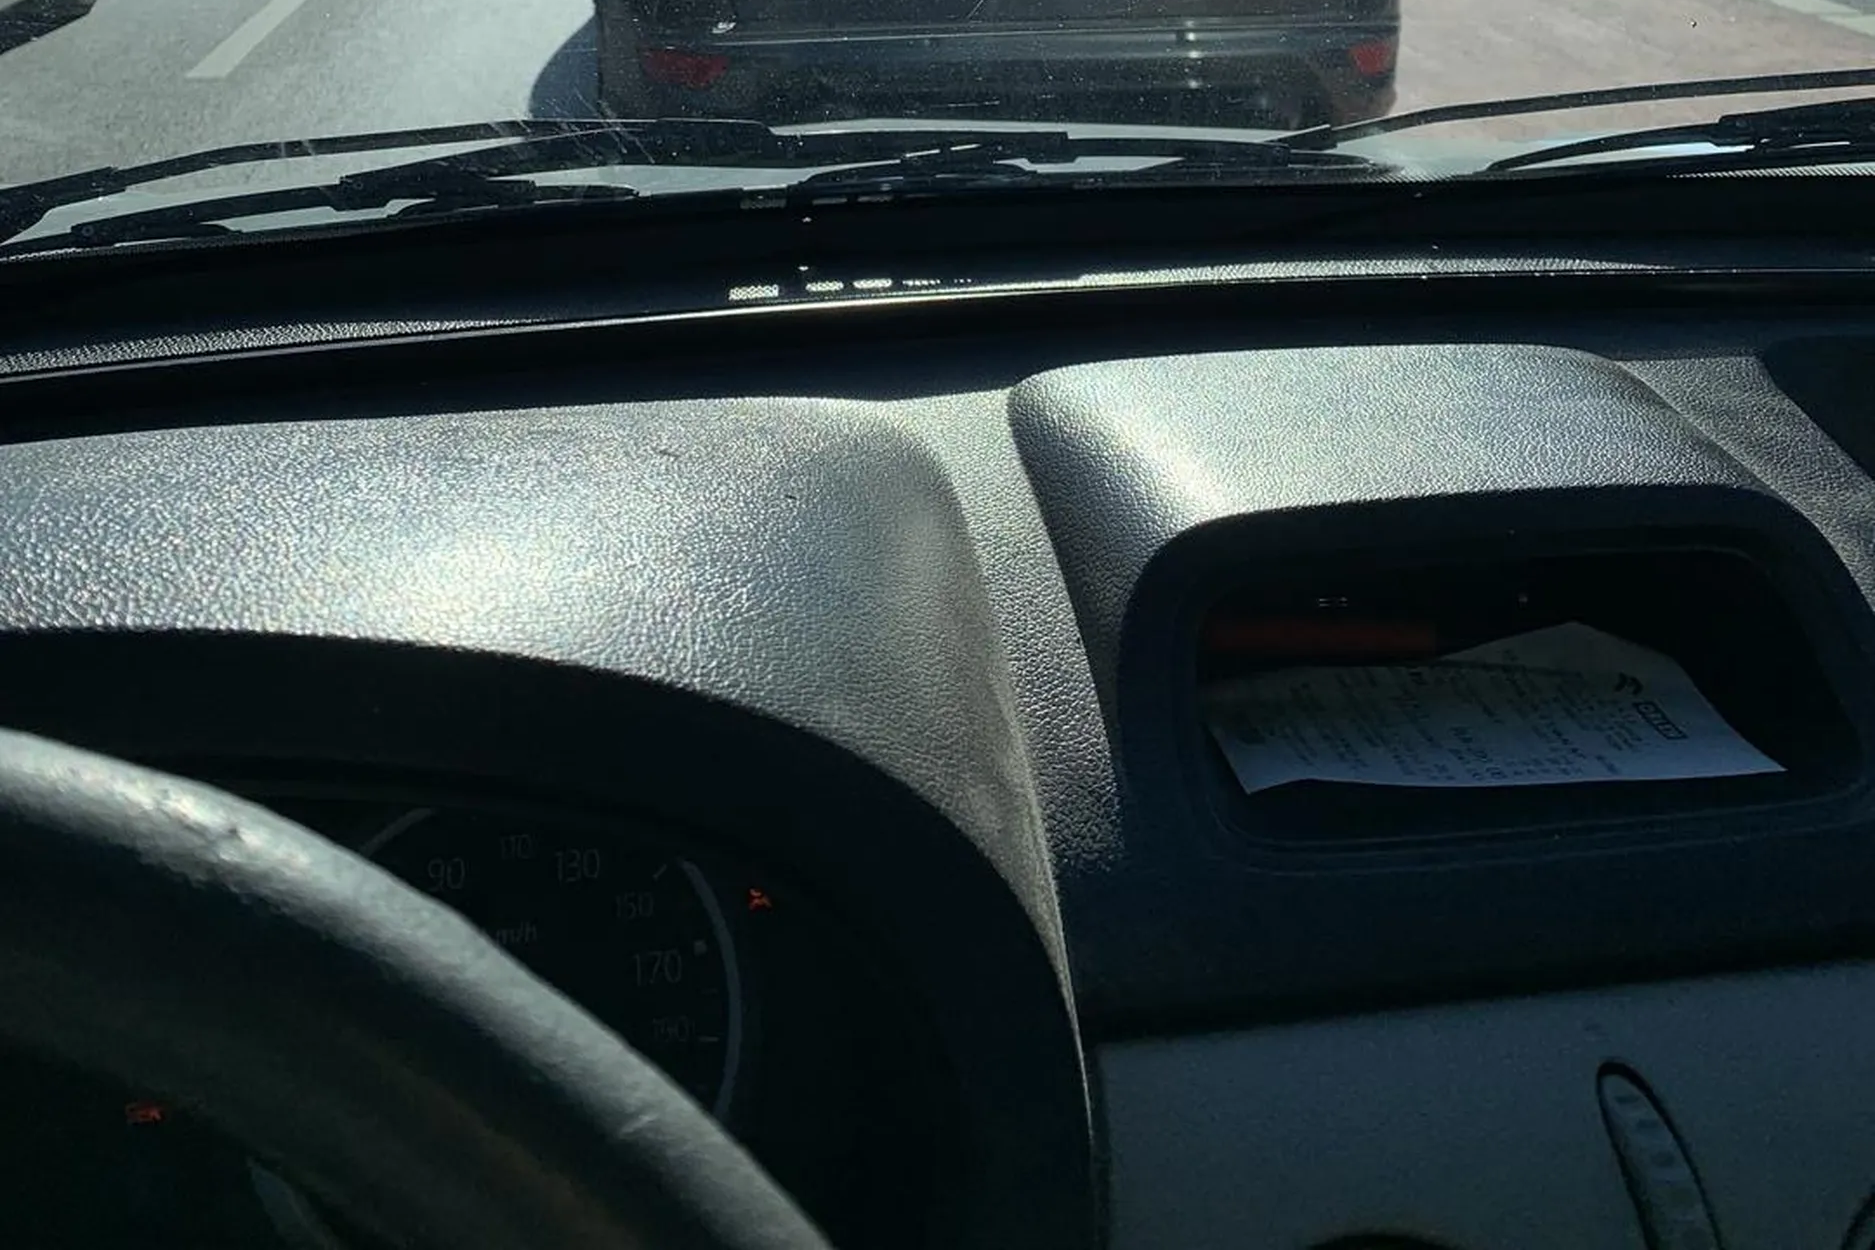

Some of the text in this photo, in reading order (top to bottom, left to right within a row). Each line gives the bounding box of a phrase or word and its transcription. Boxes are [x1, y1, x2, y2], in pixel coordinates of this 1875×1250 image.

[427, 857, 466, 891] 90
[554, 848, 600, 883] 130
[495, 920, 538, 944] m/h
[634, 952, 682, 986] 170
